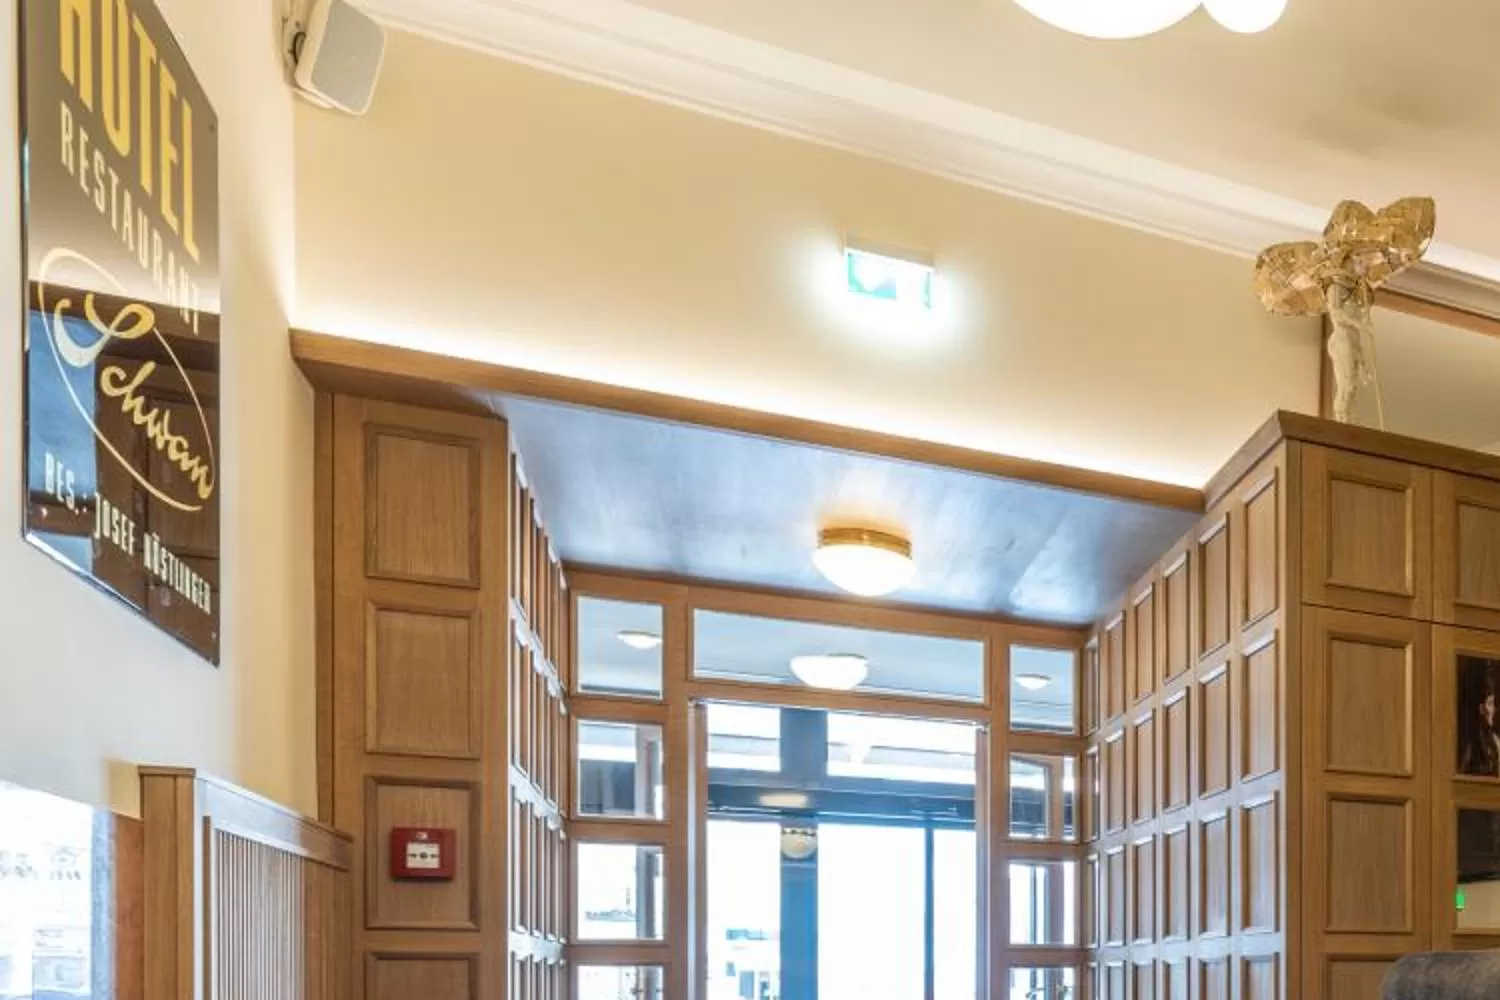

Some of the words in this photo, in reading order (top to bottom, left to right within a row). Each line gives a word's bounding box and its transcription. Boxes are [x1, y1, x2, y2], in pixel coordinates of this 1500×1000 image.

[60, 0, 200, 265] HOTEL
[61, 100, 199, 336] RESTAURANT
[53, 293, 214, 500] Schwan
[94, 491, 136, 556] JOSEF
